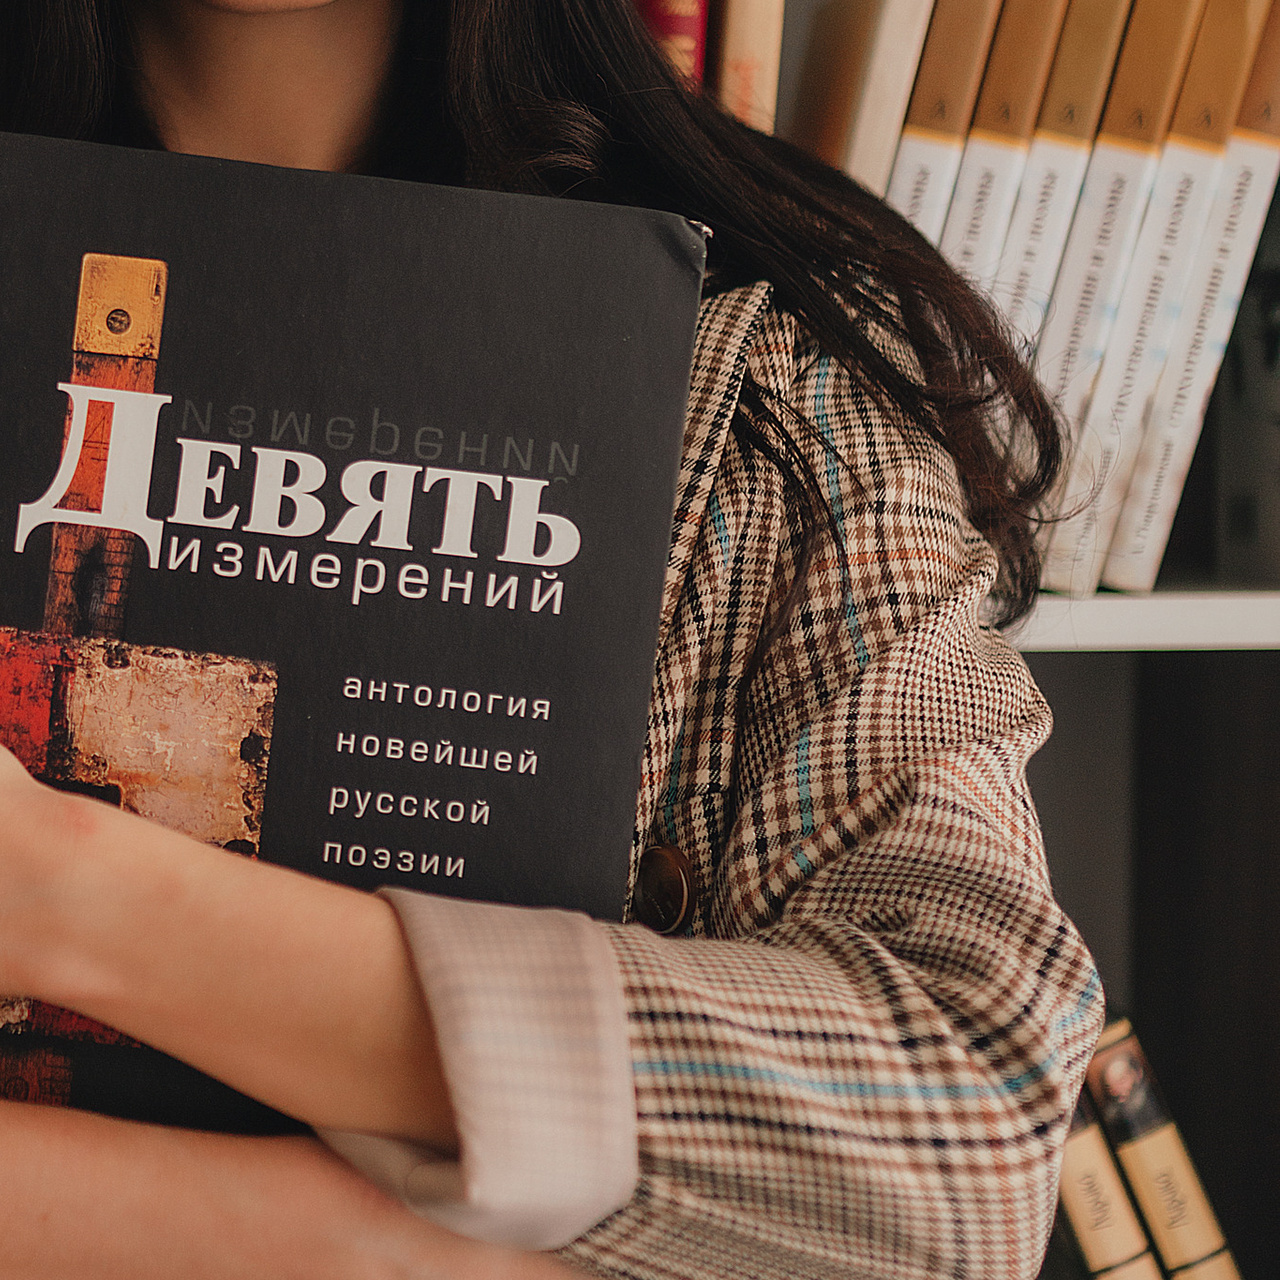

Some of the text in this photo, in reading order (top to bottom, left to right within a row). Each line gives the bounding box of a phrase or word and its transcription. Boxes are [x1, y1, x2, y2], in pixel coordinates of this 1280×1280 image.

[167, 534, 566, 615] измерений
[343, 673, 552, 720] антология
[336, 729, 539, 775] новейшей
[330, 784, 491, 827] русской
[323, 837, 466, 879] поэзии
